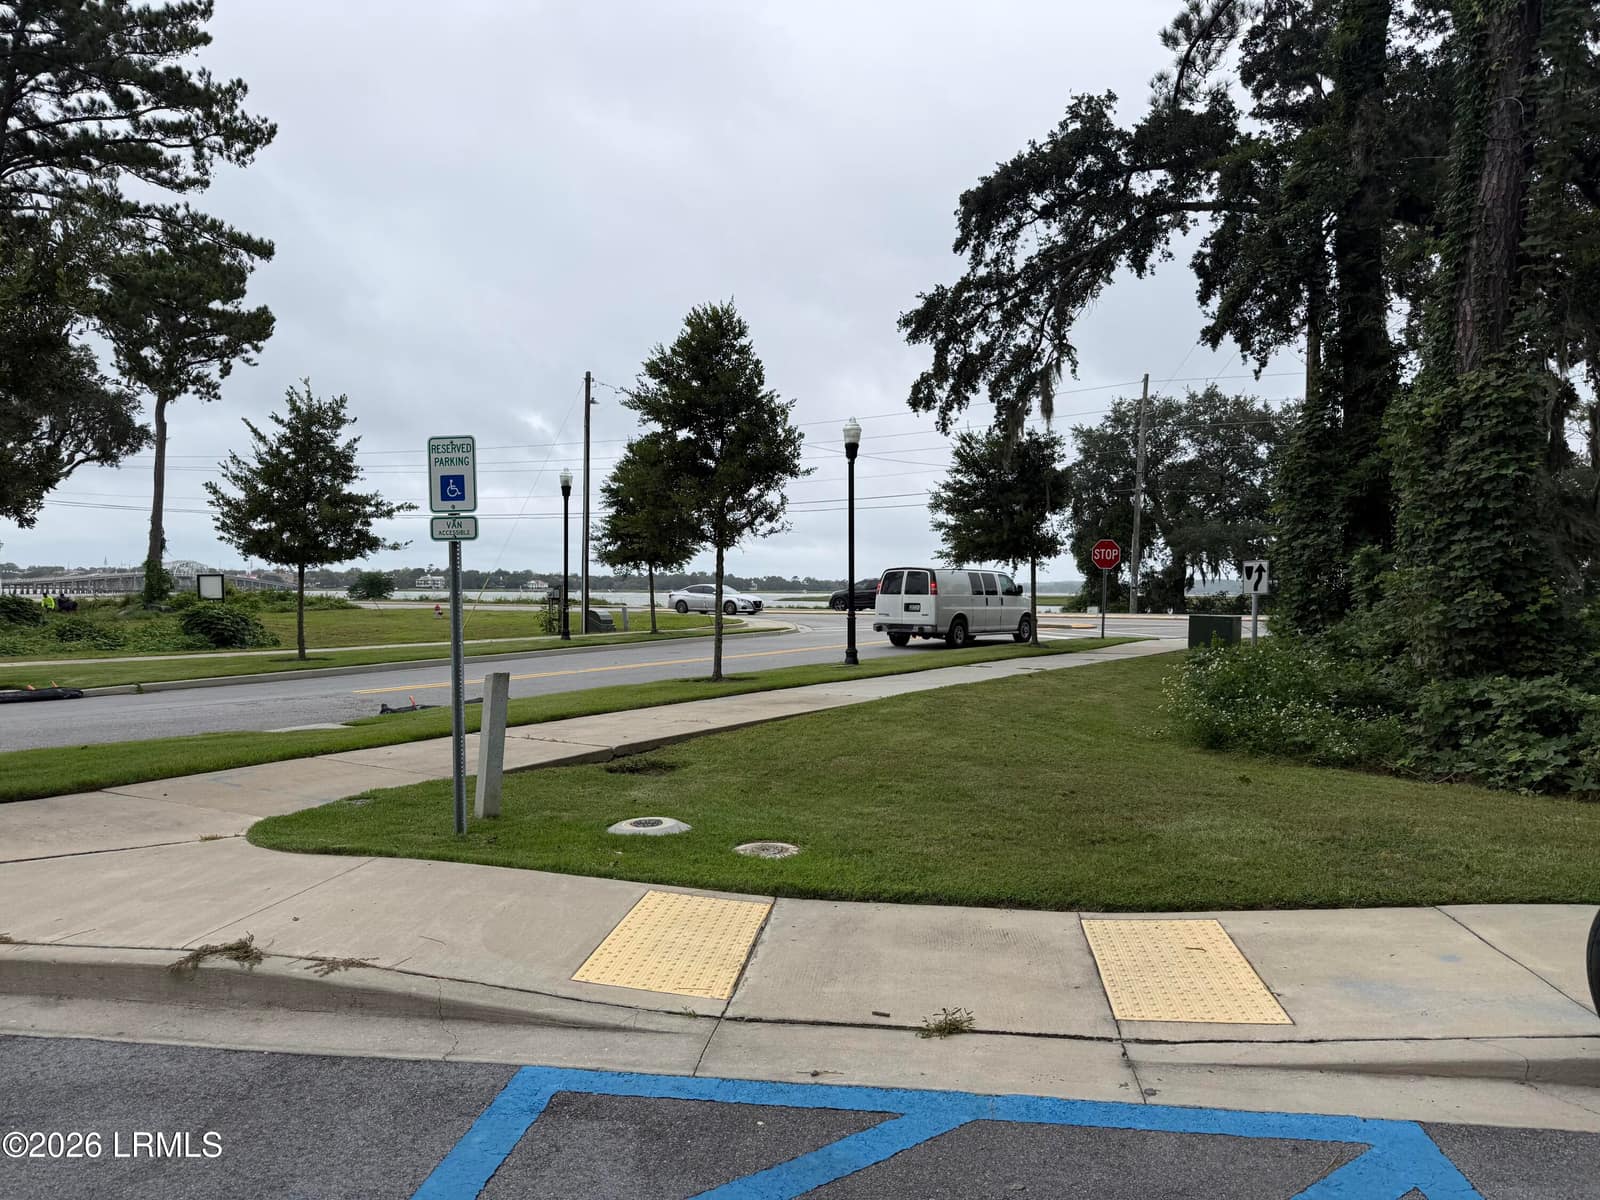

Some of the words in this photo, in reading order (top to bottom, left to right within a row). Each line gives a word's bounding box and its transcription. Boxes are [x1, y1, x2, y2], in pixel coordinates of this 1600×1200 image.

[431, 443, 472, 454] RESERVED
[434, 456, 470, 467] PARKING
[446, 520, 463, 529] VAN
[1093, 548, 1119, 560] STOP
